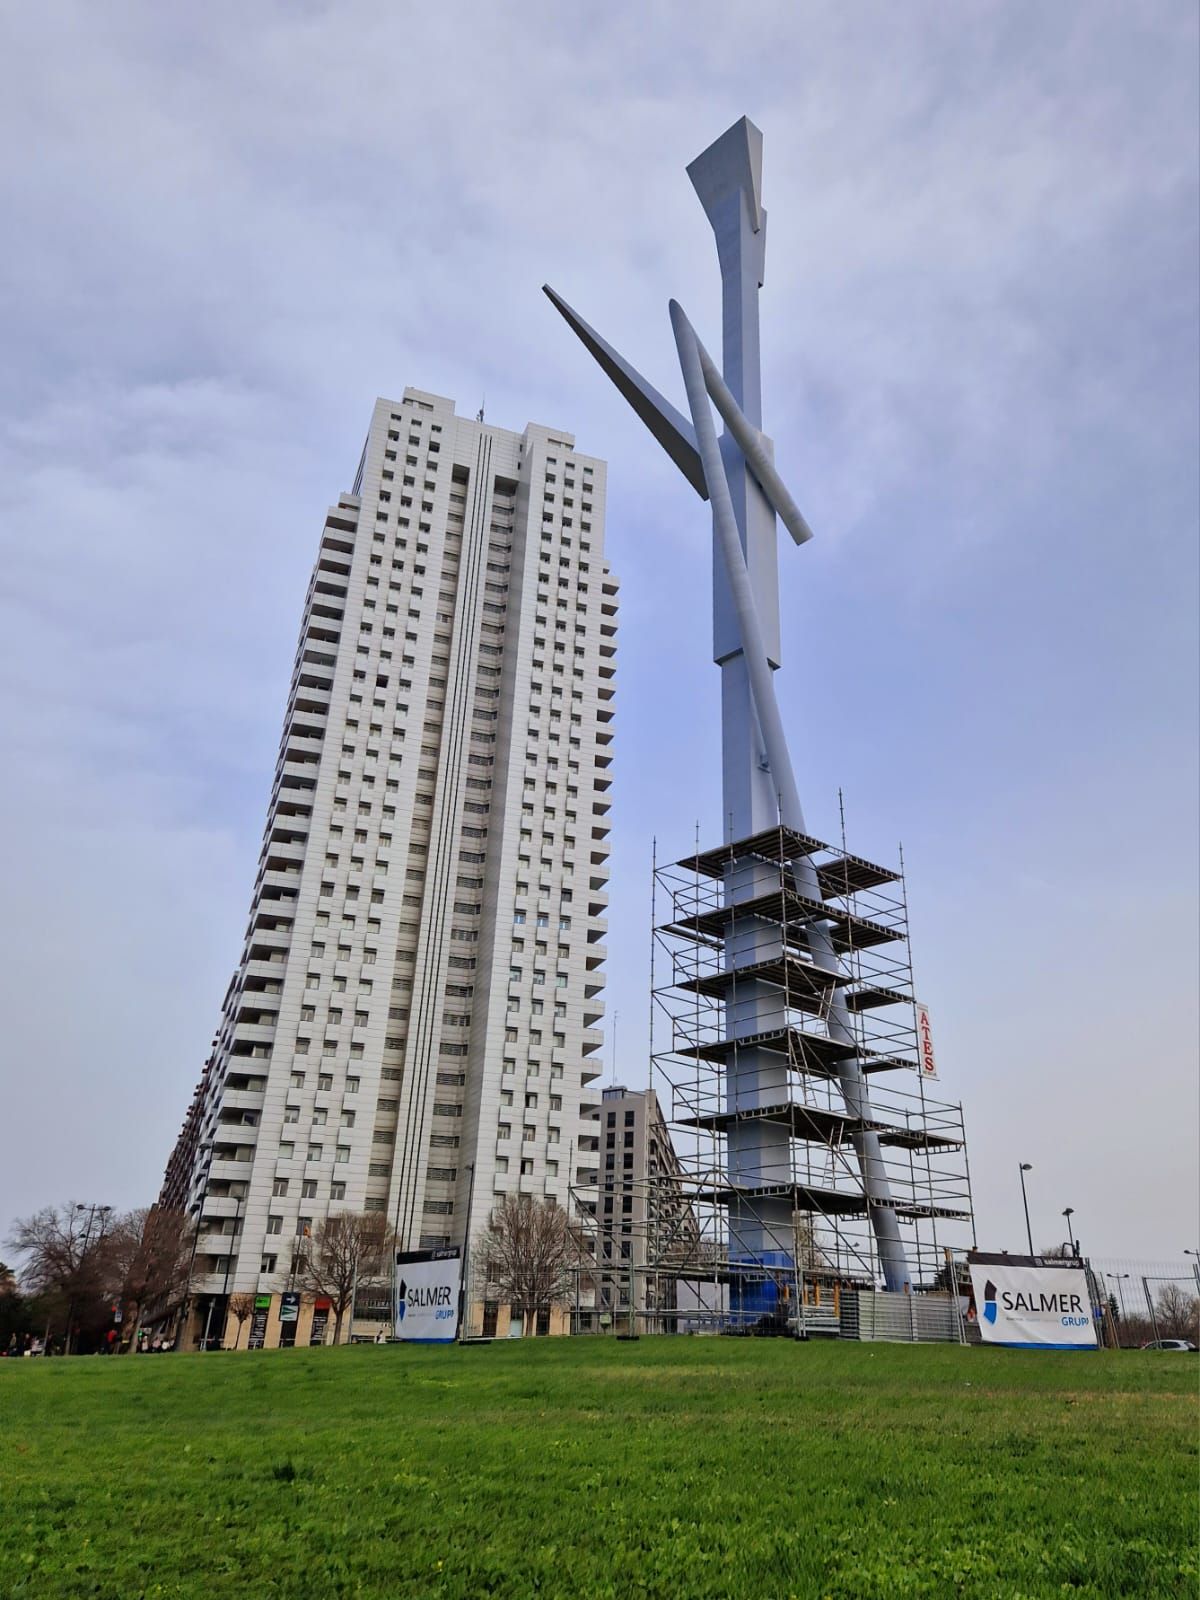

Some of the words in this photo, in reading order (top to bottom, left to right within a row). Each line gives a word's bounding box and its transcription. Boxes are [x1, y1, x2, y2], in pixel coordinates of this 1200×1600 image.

[920, 1011, 934, 1071] ATES
[407, 1286, 451, 1307] SALMER
[1002, 1291, 1083, 1313] SALMER
